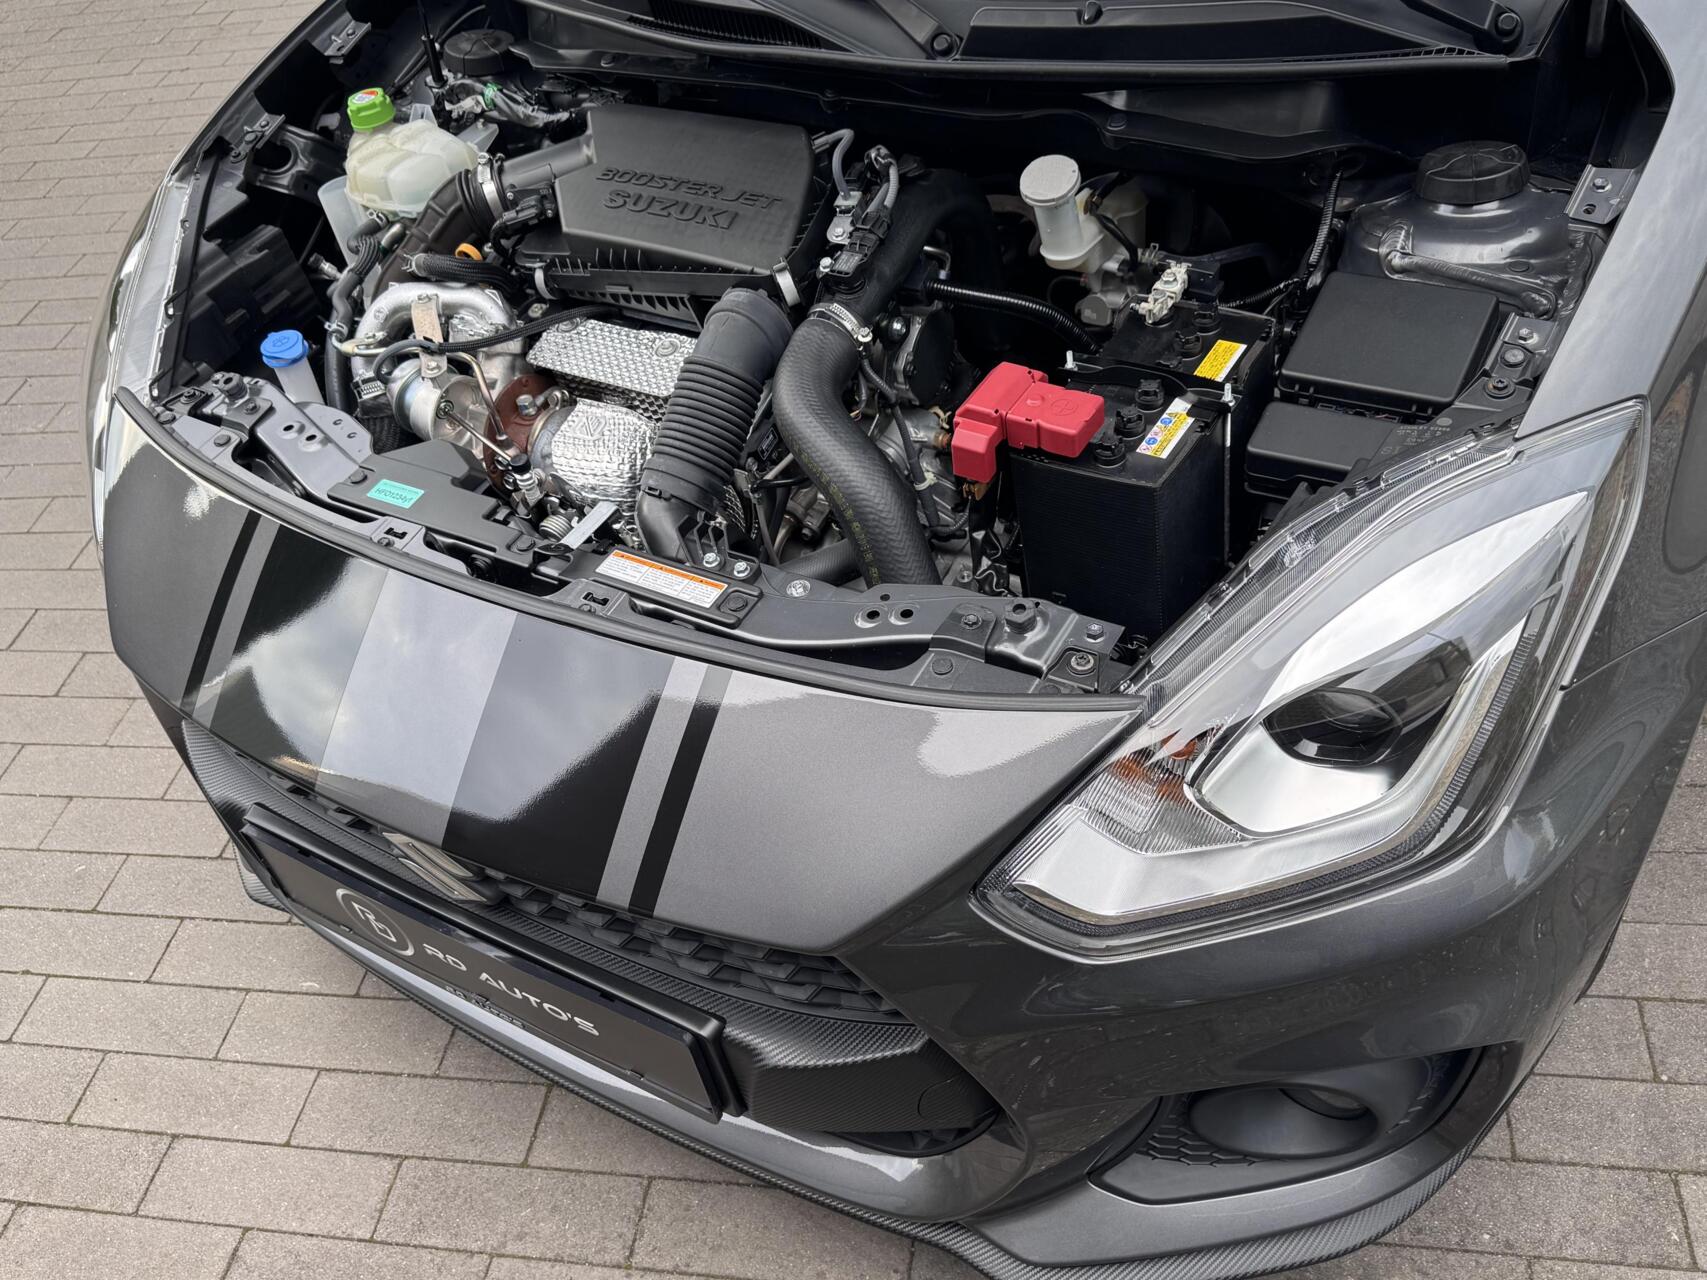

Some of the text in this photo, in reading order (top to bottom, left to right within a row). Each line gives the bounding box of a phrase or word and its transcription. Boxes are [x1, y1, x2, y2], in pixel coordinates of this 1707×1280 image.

[603, 189, 739, 230] SUZUKI
[422, 943, 468, 972] RD
[479, 972, 600, 1037] AUTO'S
